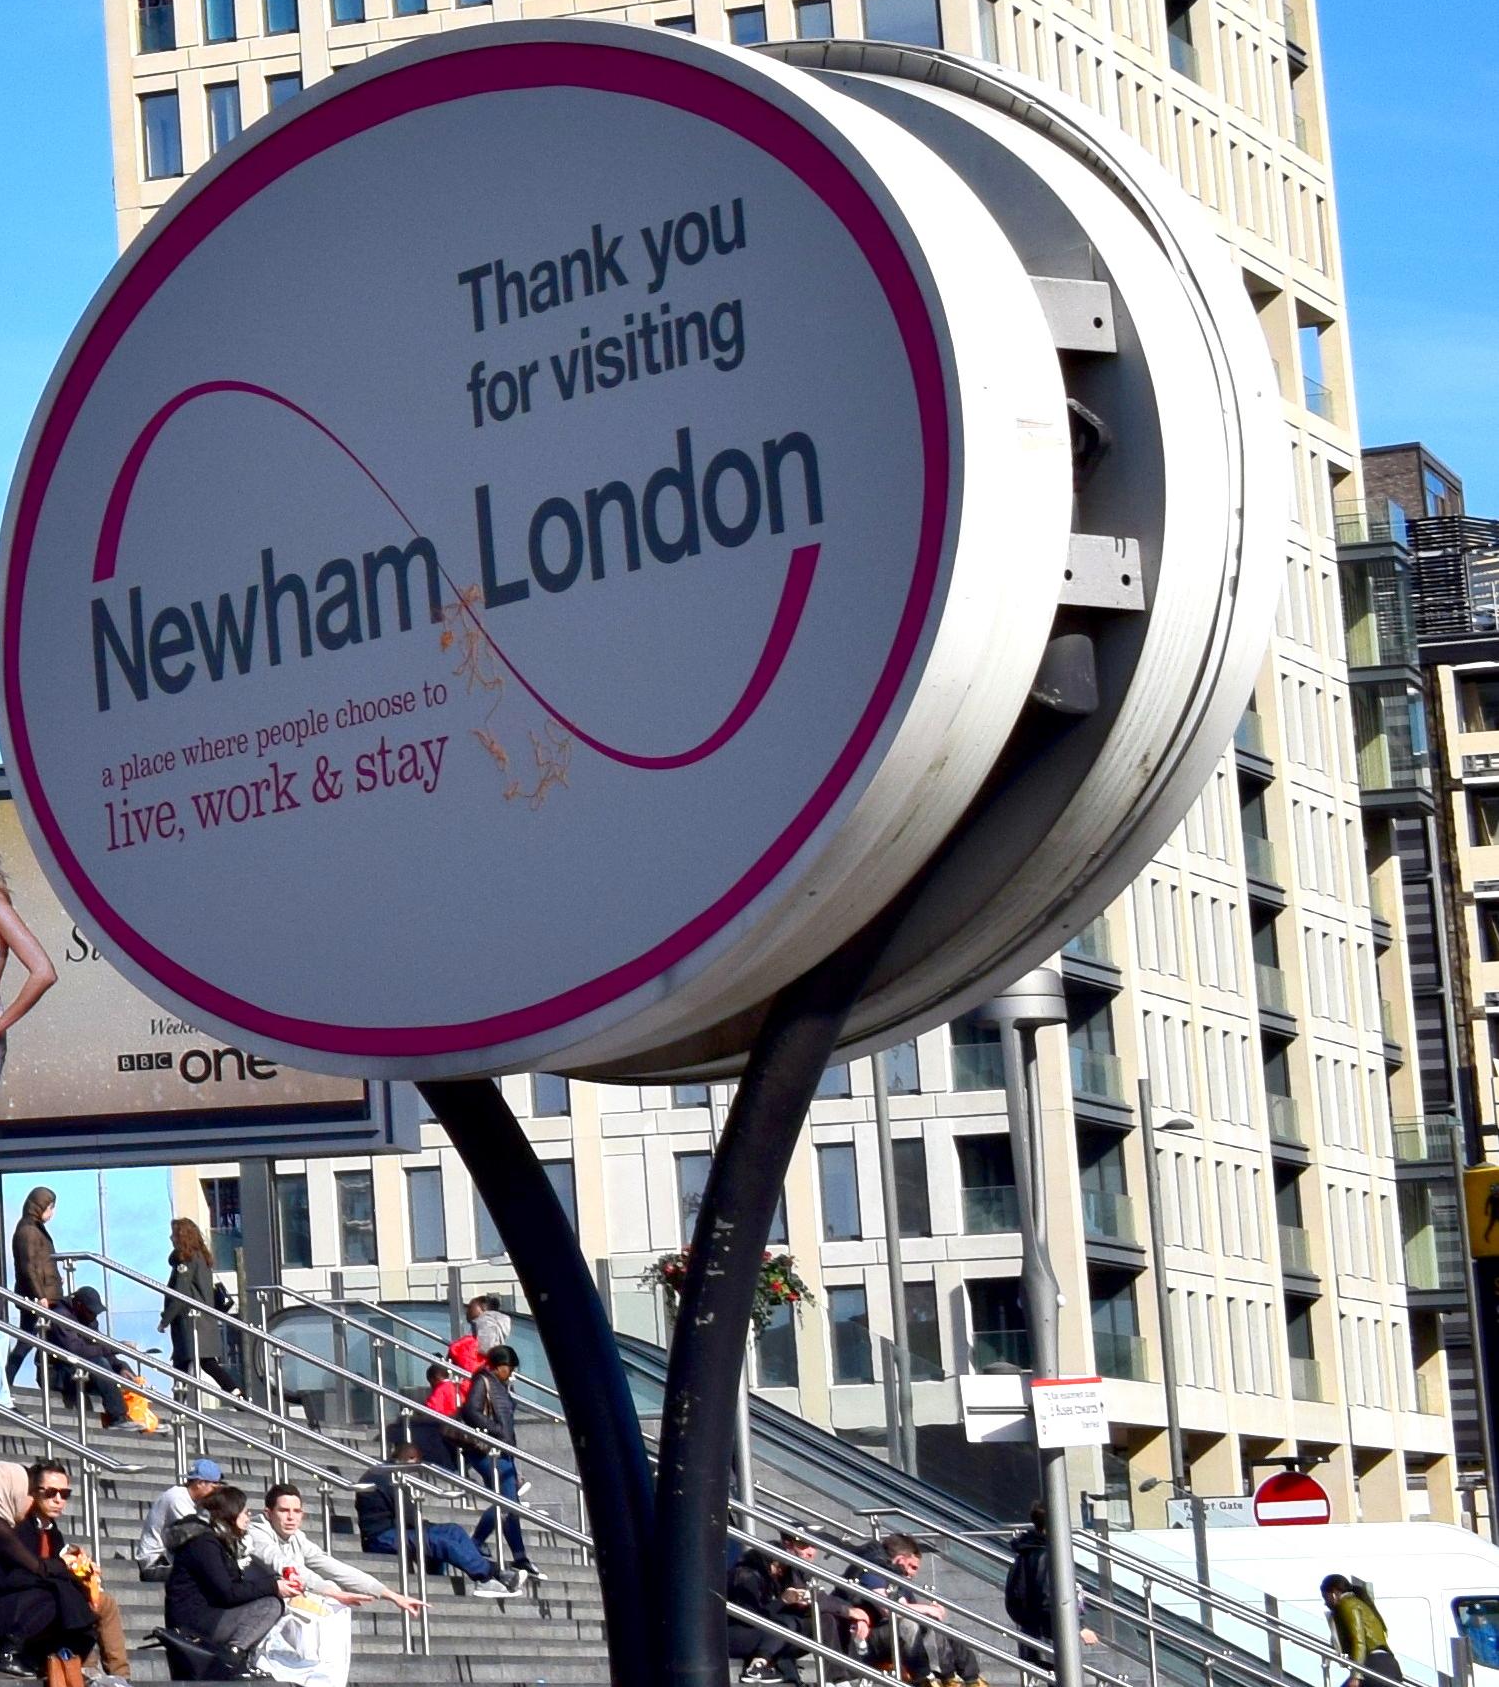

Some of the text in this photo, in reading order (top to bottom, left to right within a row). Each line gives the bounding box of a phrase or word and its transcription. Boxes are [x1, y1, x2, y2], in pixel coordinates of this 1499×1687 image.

[457, 197, 747, 333] Thank you
[466, 298, 746, 428] for visiting
[90, 426, 825, 713] Newham London
[102, 680, 448, 791] a place where people choose to
[104, 735, 450, 852] live, work & stay
[117, 1046, 278, 1085] BBC one
